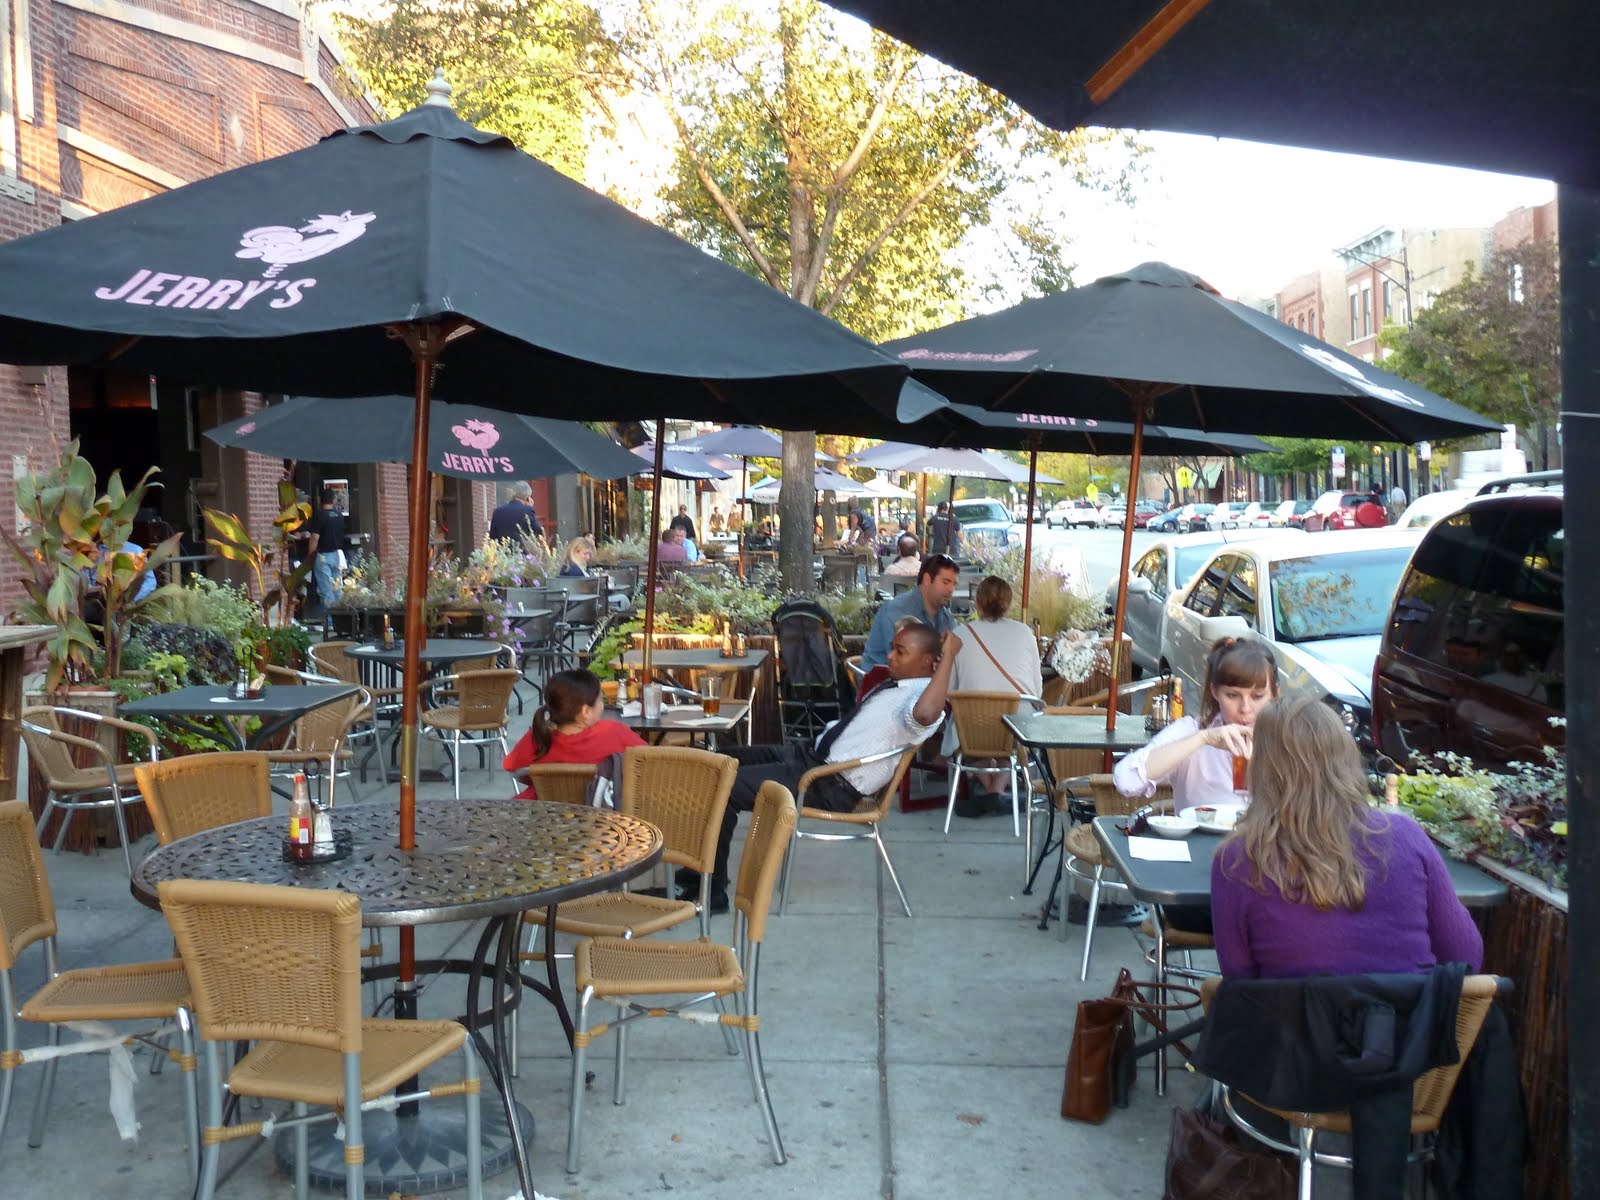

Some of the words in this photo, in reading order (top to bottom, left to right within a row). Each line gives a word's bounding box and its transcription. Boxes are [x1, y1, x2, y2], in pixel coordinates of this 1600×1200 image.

[95, 269, 317, 310] JERRY'S
[1016, 413, 1098, 427] JERRYS
[442, 452, 514, 474] JERRY'S
[923, 466, 987, 478] GUINNESS
